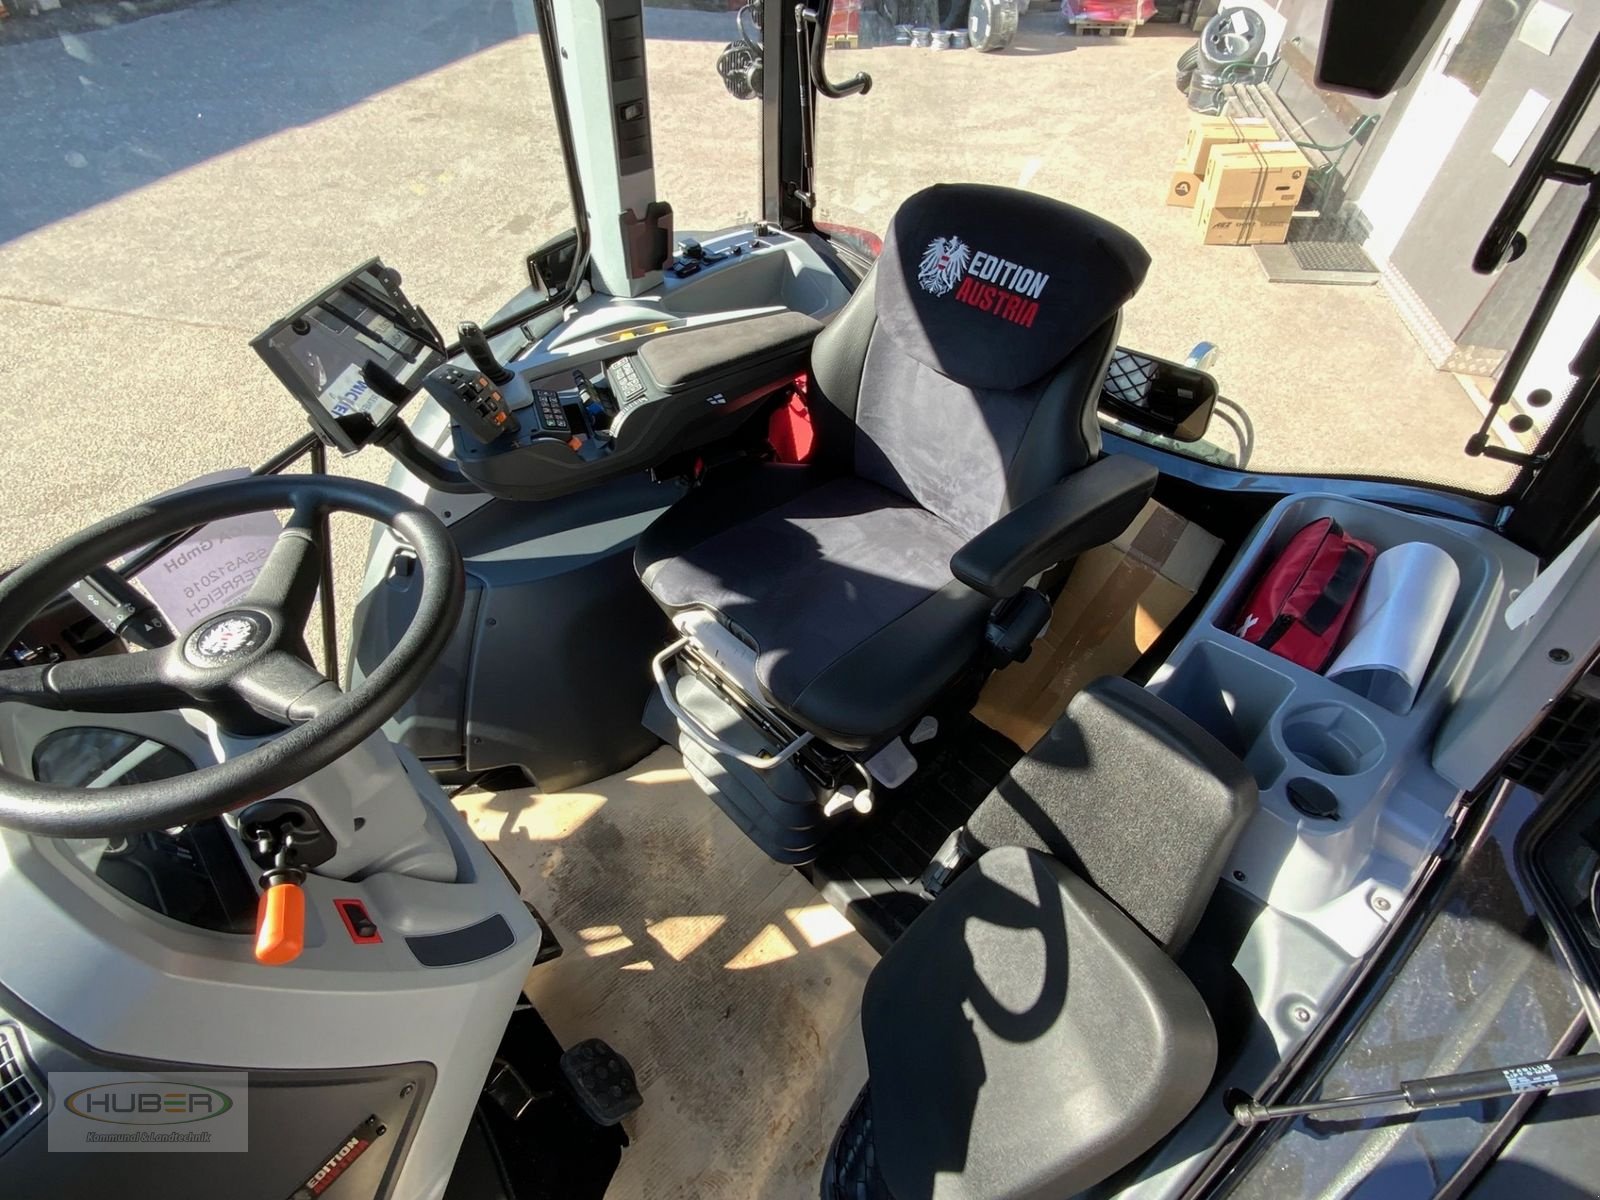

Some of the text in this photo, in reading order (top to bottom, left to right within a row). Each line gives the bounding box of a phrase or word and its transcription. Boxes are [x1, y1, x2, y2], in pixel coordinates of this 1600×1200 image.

[967, 251, 1050, 299] EDITION
[955, 276, 1040, 328] AUSTRIA
[305, 1136, 359, 1189] EDITION
